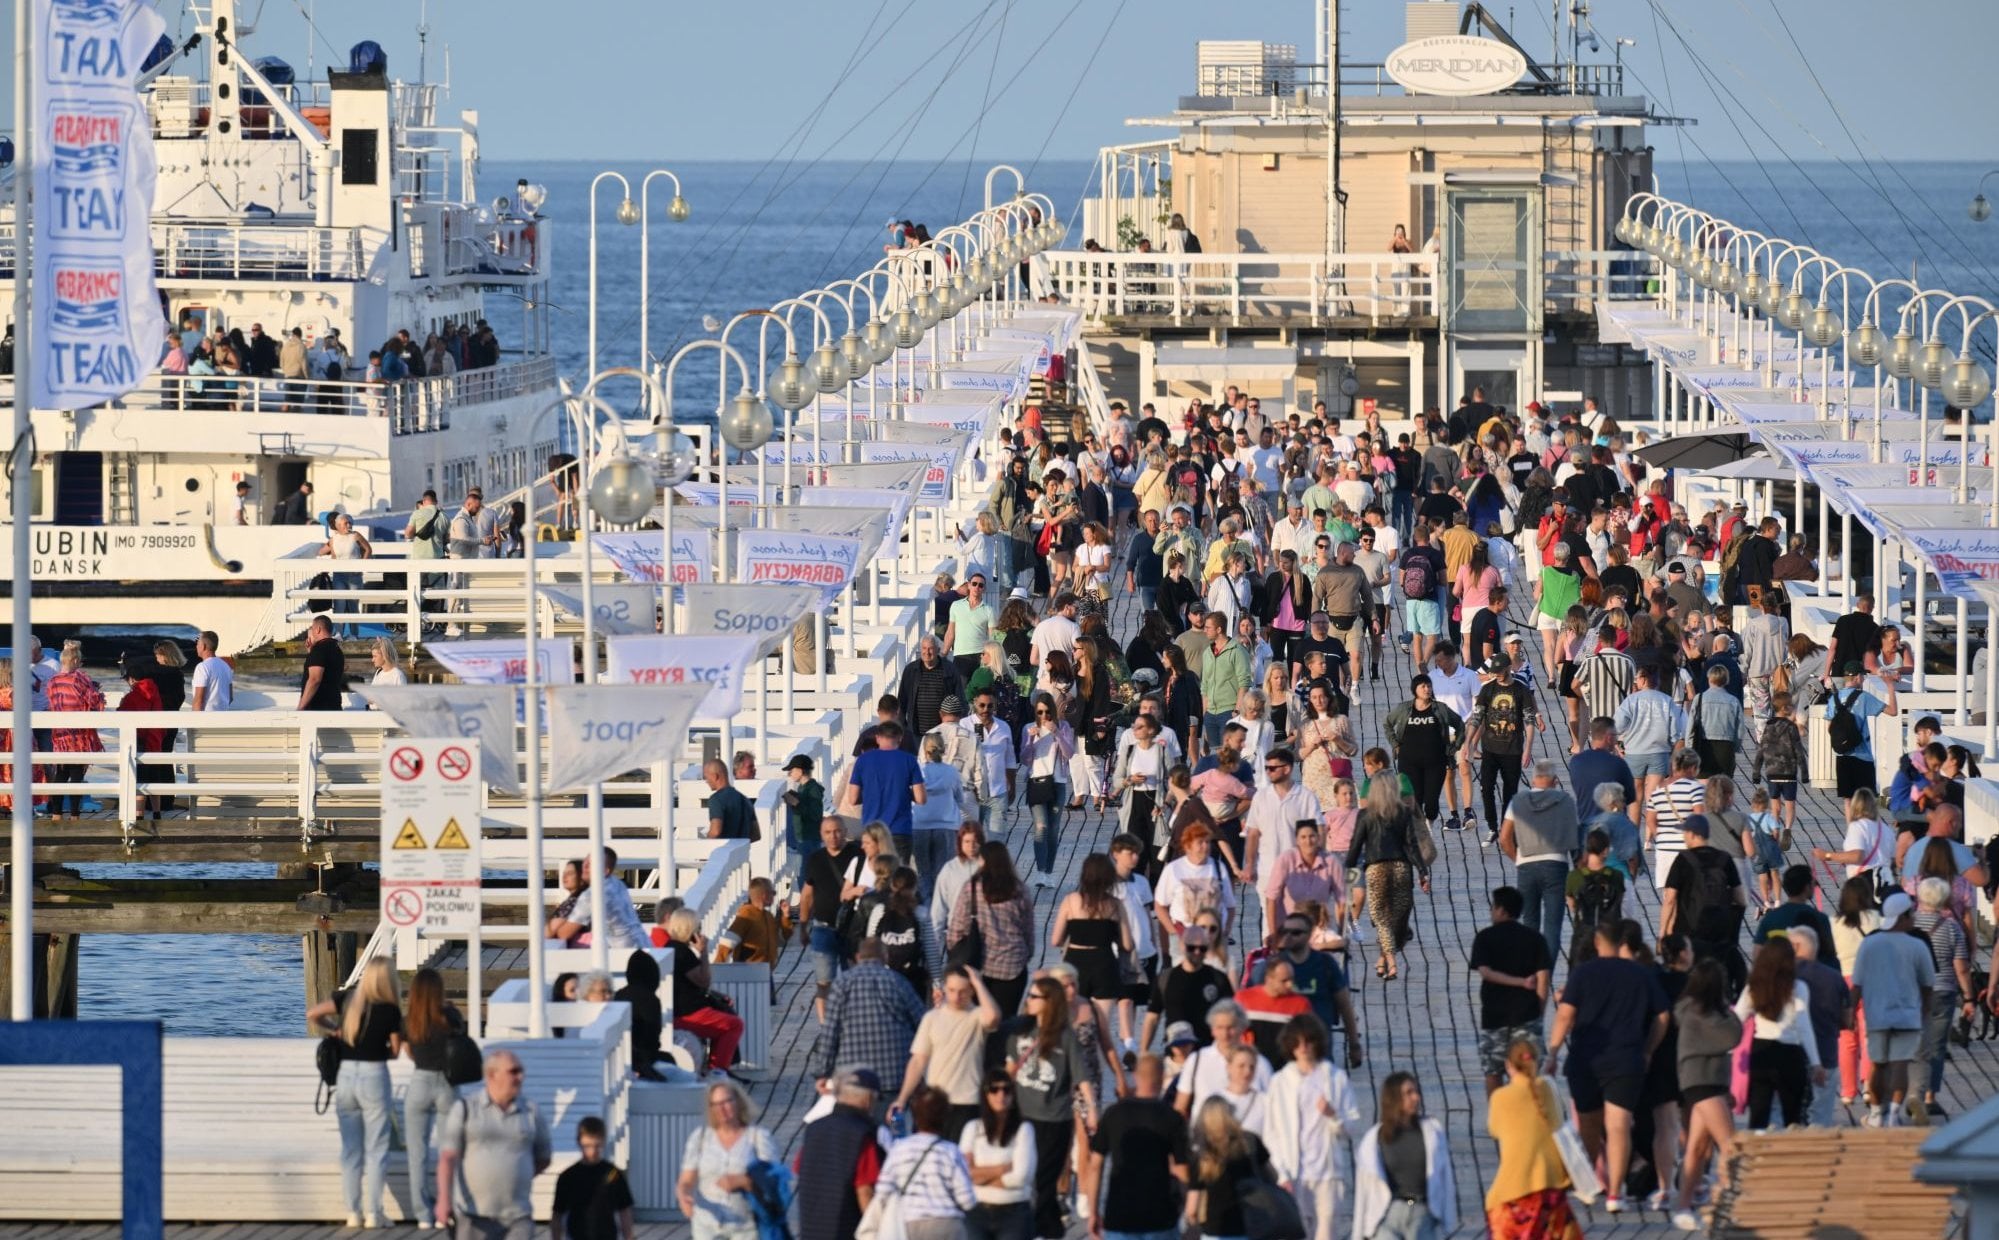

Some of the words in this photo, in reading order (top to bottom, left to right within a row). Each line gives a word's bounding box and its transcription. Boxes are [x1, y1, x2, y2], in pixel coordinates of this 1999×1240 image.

[1396, 57, 1519, 82] MERIDIAN
[36, 531, 108, 555] UBIN
[115, 536, 135, 547] IMO
[141, 536, 196, 547] 7909920
[33, 556, 102, 574] DAŃSK
[714, 609, 792, 633] Sopot
[1408, 717, 1436, 725] LOVE
